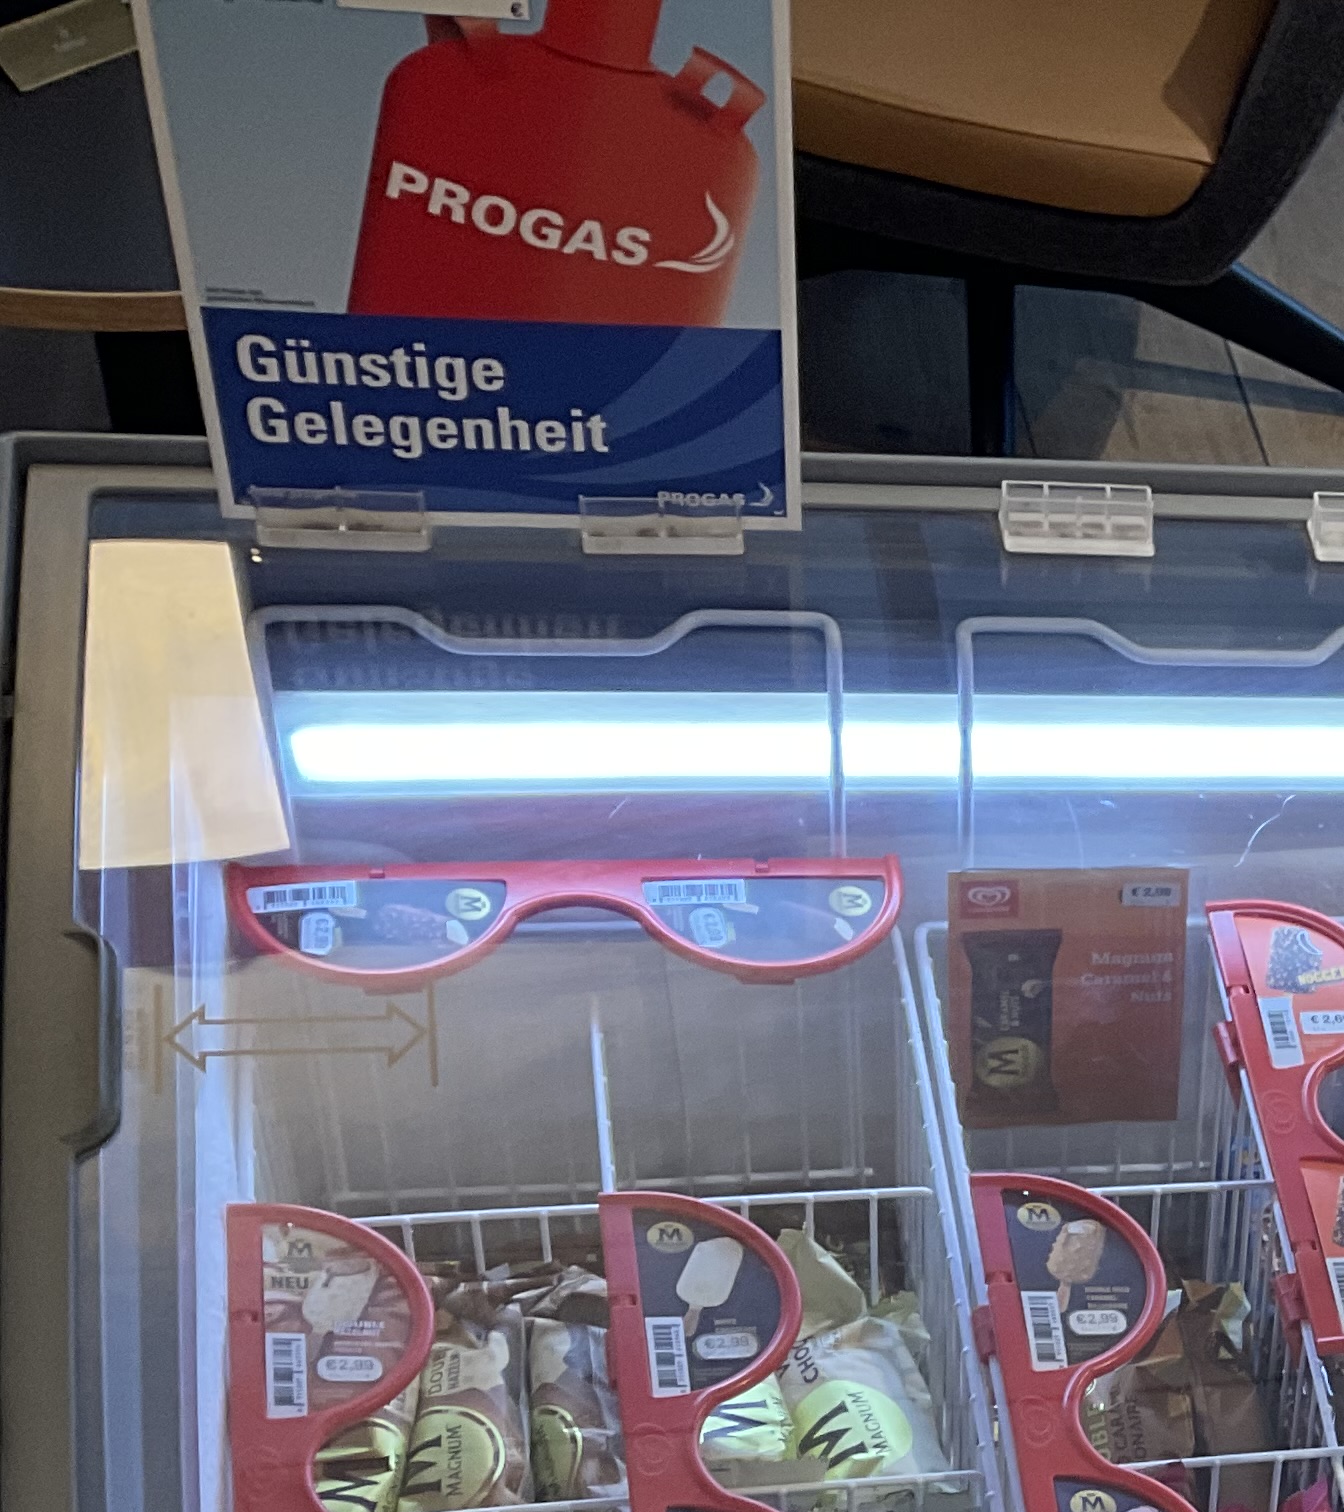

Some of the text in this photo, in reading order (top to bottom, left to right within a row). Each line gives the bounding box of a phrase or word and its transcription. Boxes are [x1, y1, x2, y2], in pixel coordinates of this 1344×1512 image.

[385, 160, 652, 266] PROGAS
[236, 334, 505, 401] Günstige
[246, 397, 609, 459] Gelegenheit
[657, 490, 746, 507] PROGAS
[271, 1276, 309, 1290] NEU
[798, 1400, 869, 1469] M
[848, 1390, 890, 1456] MAGNUM
[446, 1423, 462, 1497] MAGNUM
[1081, 1494, 1105, 1512] M
